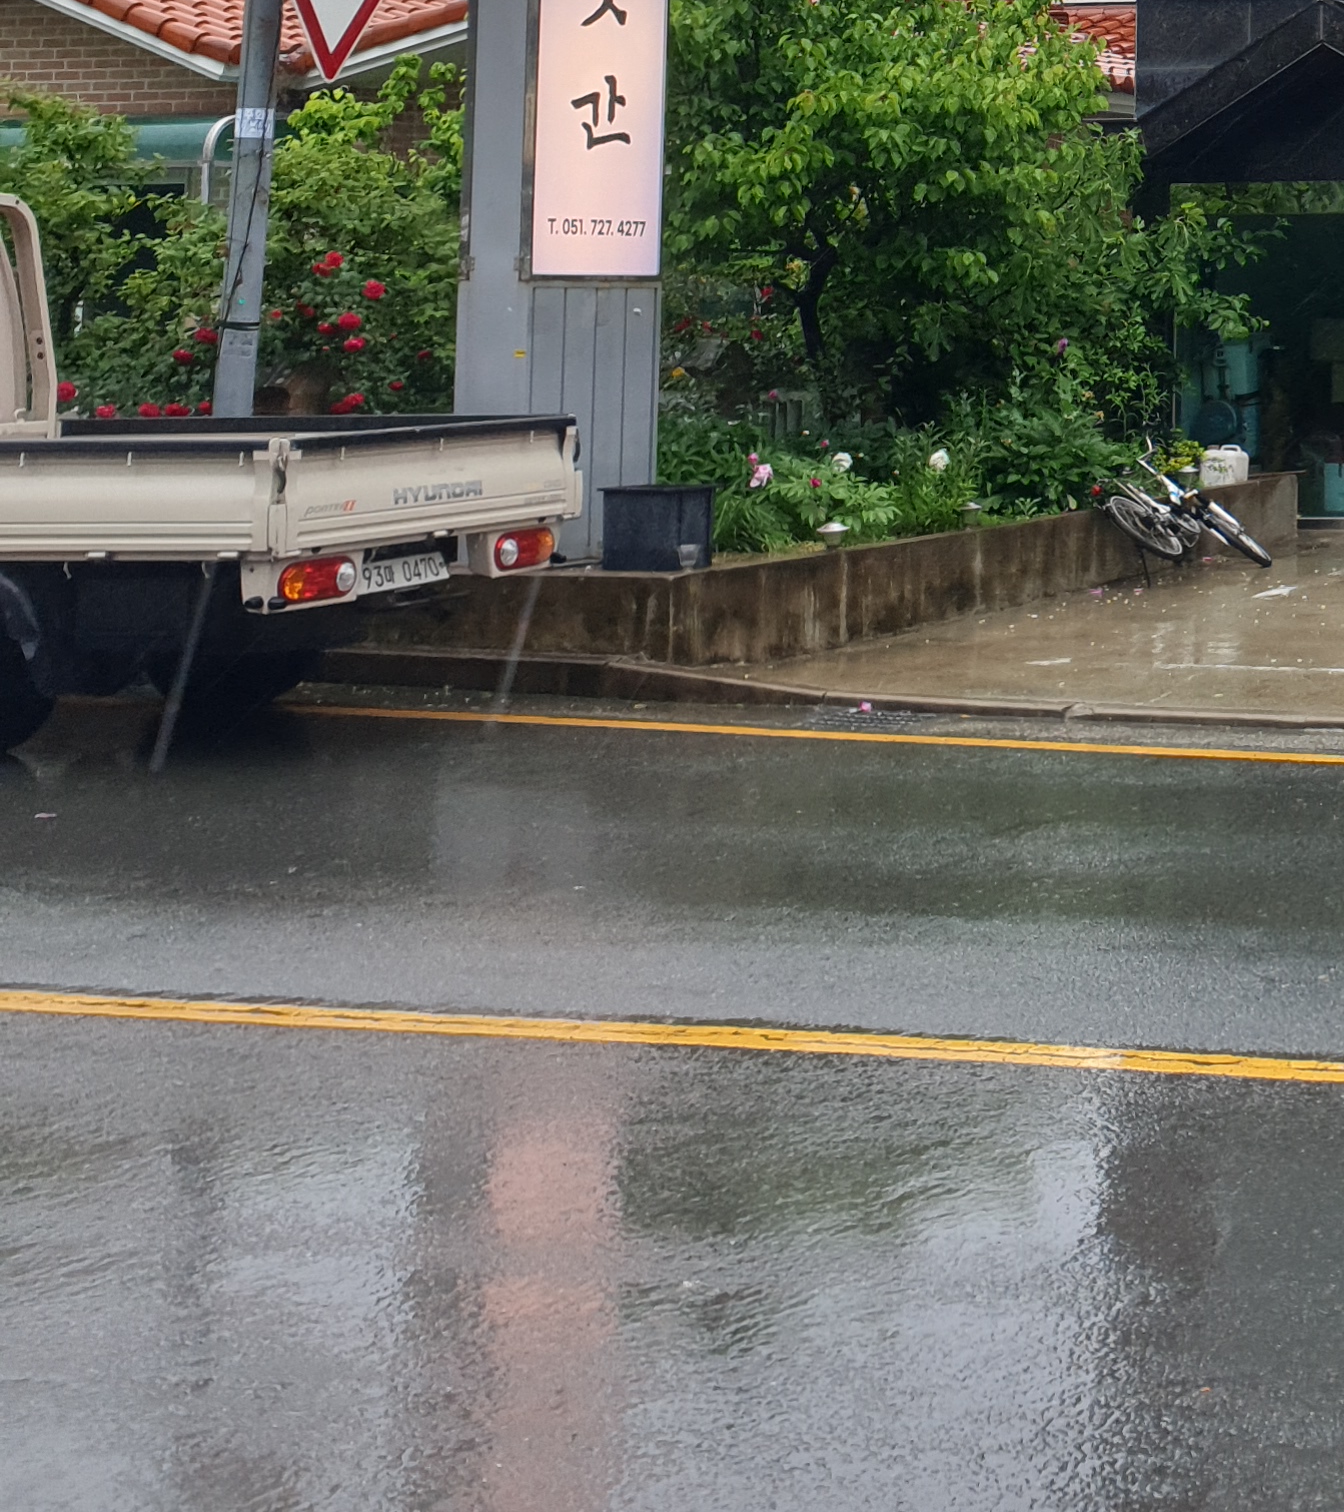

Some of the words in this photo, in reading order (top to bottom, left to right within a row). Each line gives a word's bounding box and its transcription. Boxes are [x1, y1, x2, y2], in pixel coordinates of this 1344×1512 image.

[547, 218, 559, 235] T.
[562, 218, 587, 235] 051.
[590, 219, 614, 236] 727.
[617, 220, 646, 237] 4277
[393, 480, 483, 506] HYUNDAI
[362, 564, 395, 590] 93마
[402, 555, 440, 583] 0470
